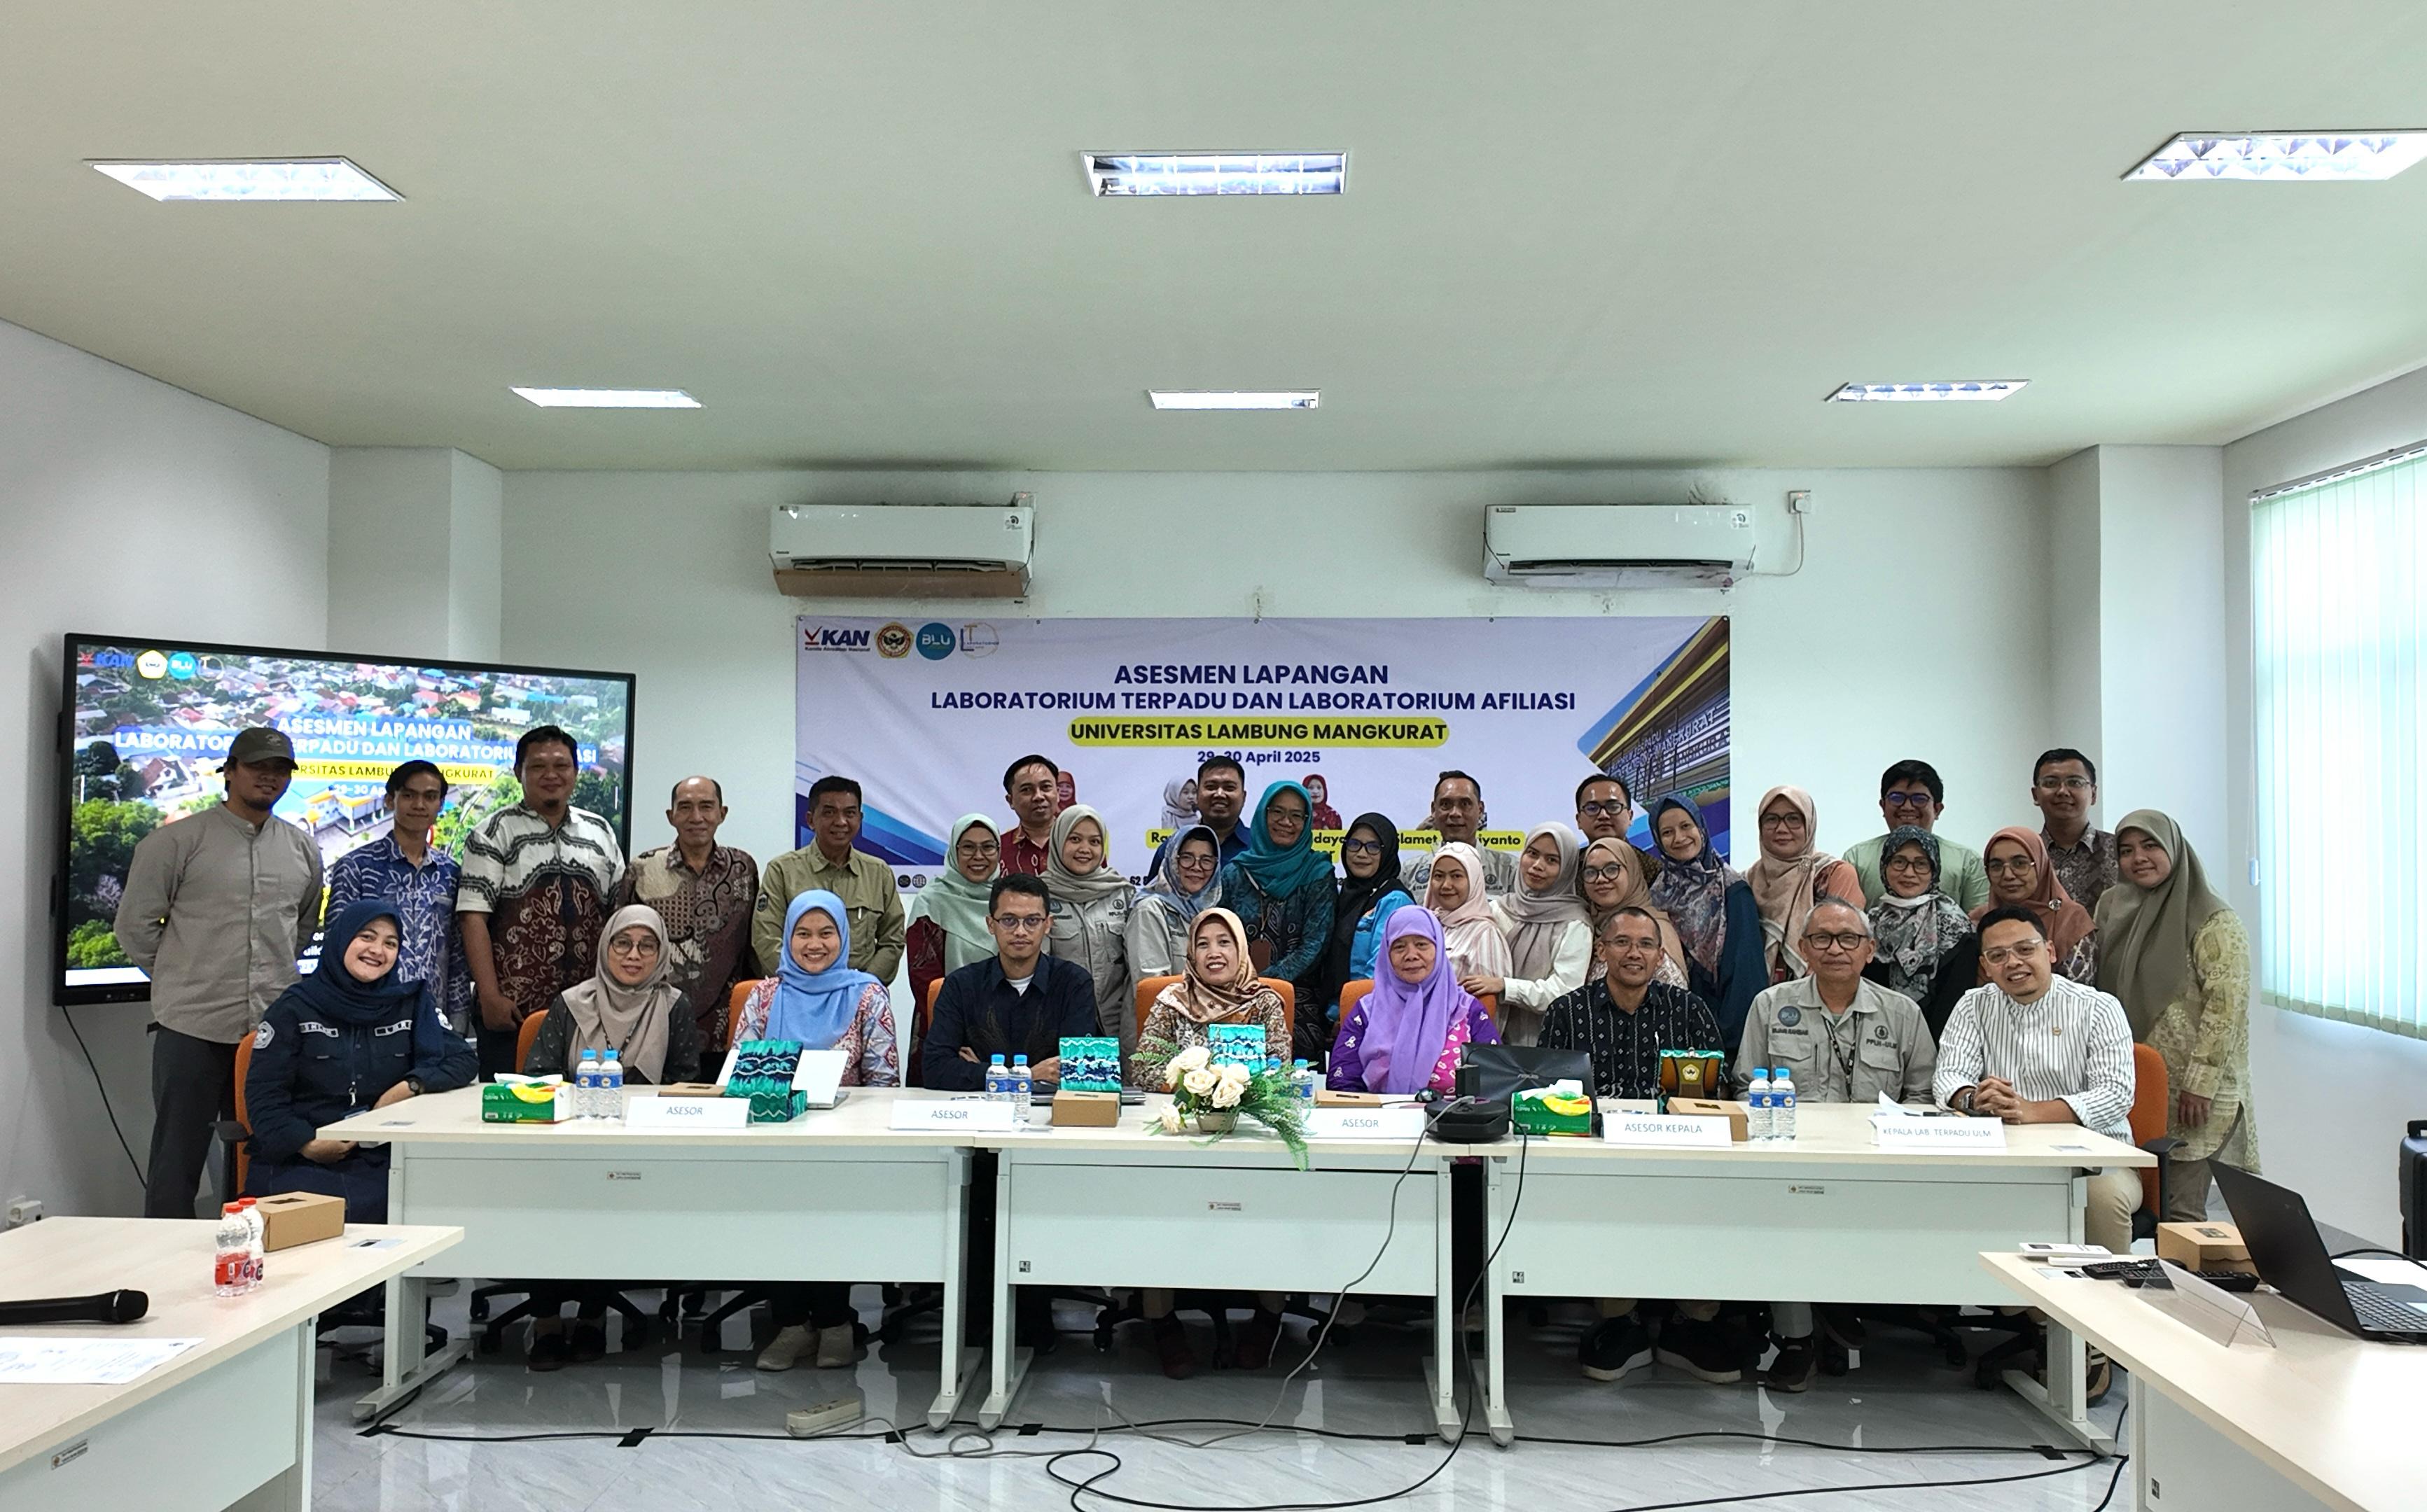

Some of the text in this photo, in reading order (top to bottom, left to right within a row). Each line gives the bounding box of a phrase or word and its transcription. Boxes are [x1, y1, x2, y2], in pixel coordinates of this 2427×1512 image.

[821, 629, 870, 646] KAN
[922, 634, 950, 645] BLU
[171, 660, 193, 669] BLU
[1114, 665, 1388, 685] ASESMEN LAPANGAN
[931, 692, 1575, 710] LABORATORIUM TERPADU DAN LABORATORIUM AFILIASI
[277, 718, 471, 741] ASESMEN LAPANGAN
[1071, 724, 1447, 740] UNIVERSITAS LAMBUNG MANGKURAT
[116, 732, 517, 761] LABORATOR ERPADU DAN LABORATORIU
[1197, 750, 1320, 766] 2930 April 2025
[349, 766, 394, 777] LAMBU
[443, 769, 494, 779] GKURAT
[1398, 832, 1521, 848] lamet iyanto
[666, 1106, 703, 1116] ASESOR
[931, 1110, 968, 1119] ASESOR
[1342, 1119, 1379, 1128] ASESOR
[1625, 1123, 1703, 1133] ASESOR KEPALA
[1883, 1128, 1913, 1136] KEPALA
[1933, 1128, 1970, 1137] TERPADU
